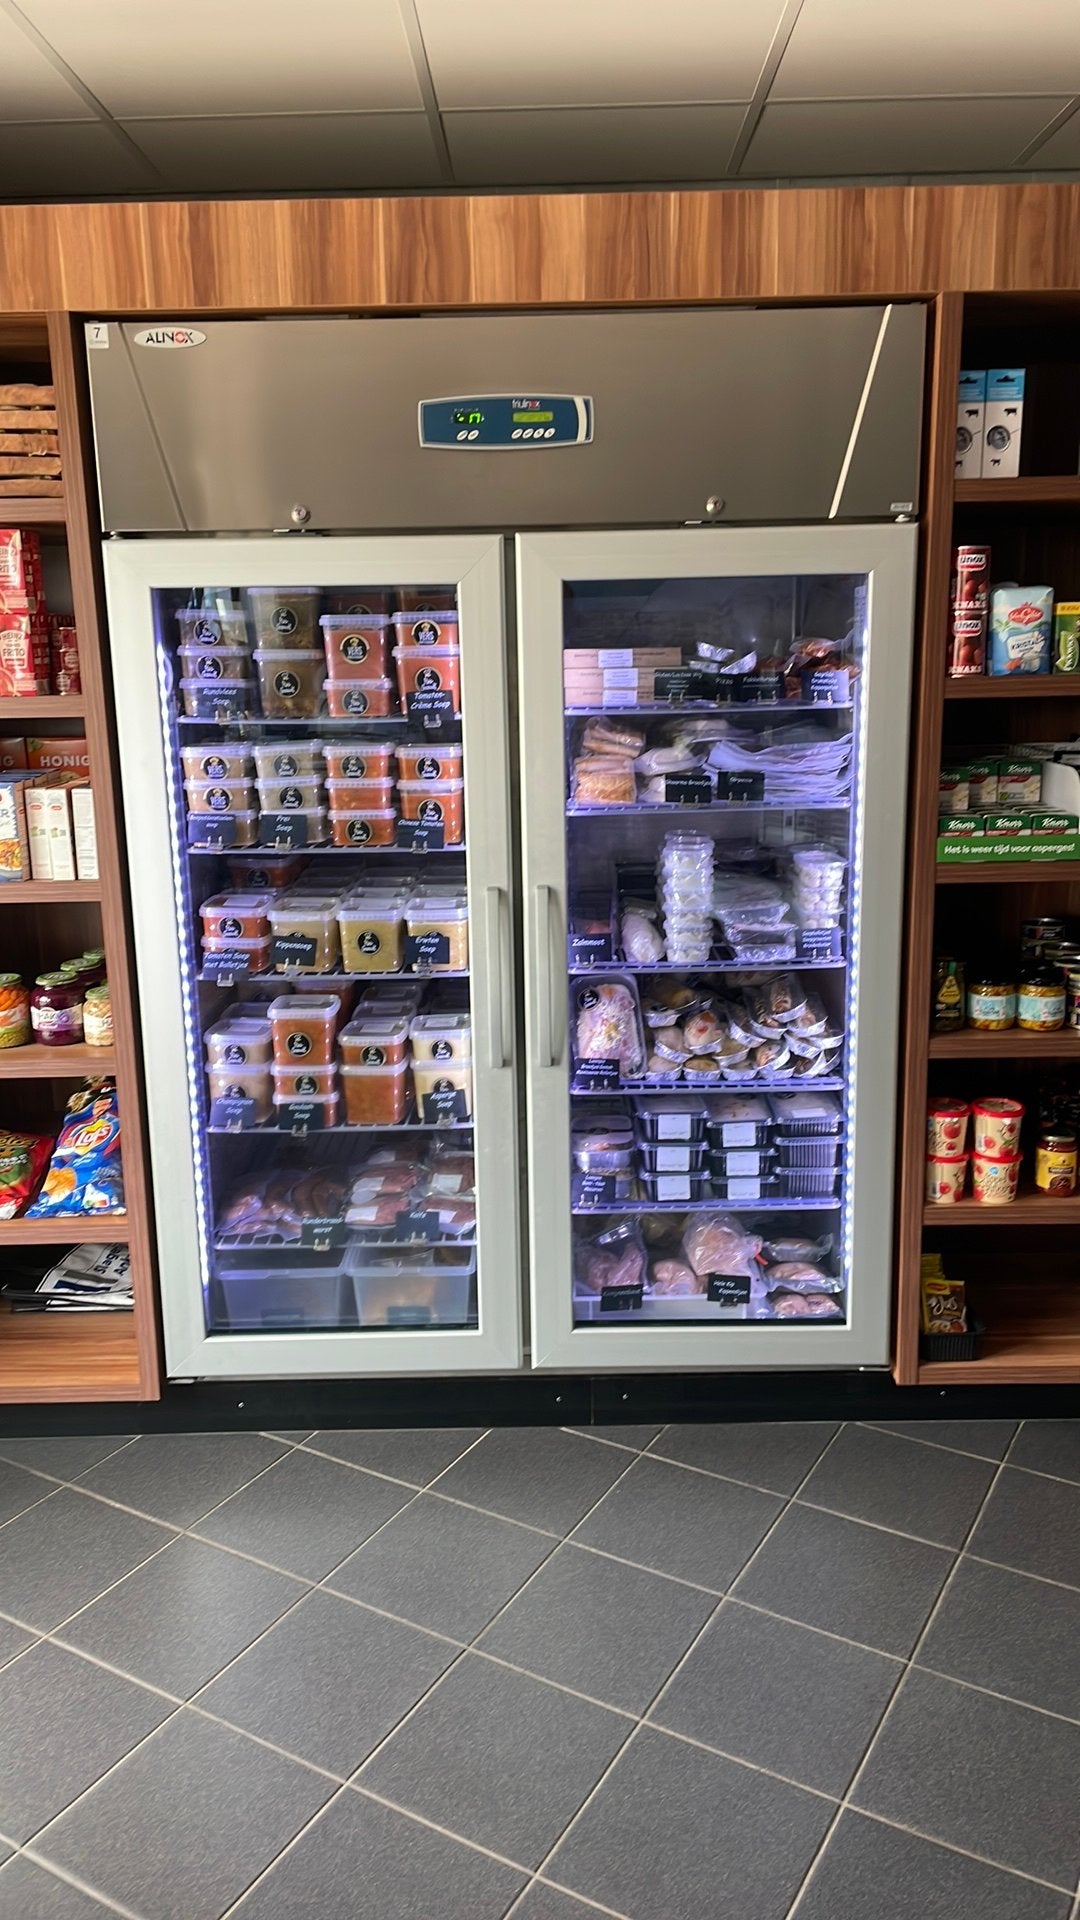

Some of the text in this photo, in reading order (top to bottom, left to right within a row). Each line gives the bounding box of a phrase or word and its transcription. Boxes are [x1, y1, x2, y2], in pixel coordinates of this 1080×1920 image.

[93, 327, 101, 338] 7
[40, 755, 90, 767] HONIG
[944, 845, 961, 854] Het
[962, 845, 970, 853] is
[971, 845, 993, 853] weer
[993, 844, 1010, 855] tijd
[1011, 845, 1031, 853] voor
